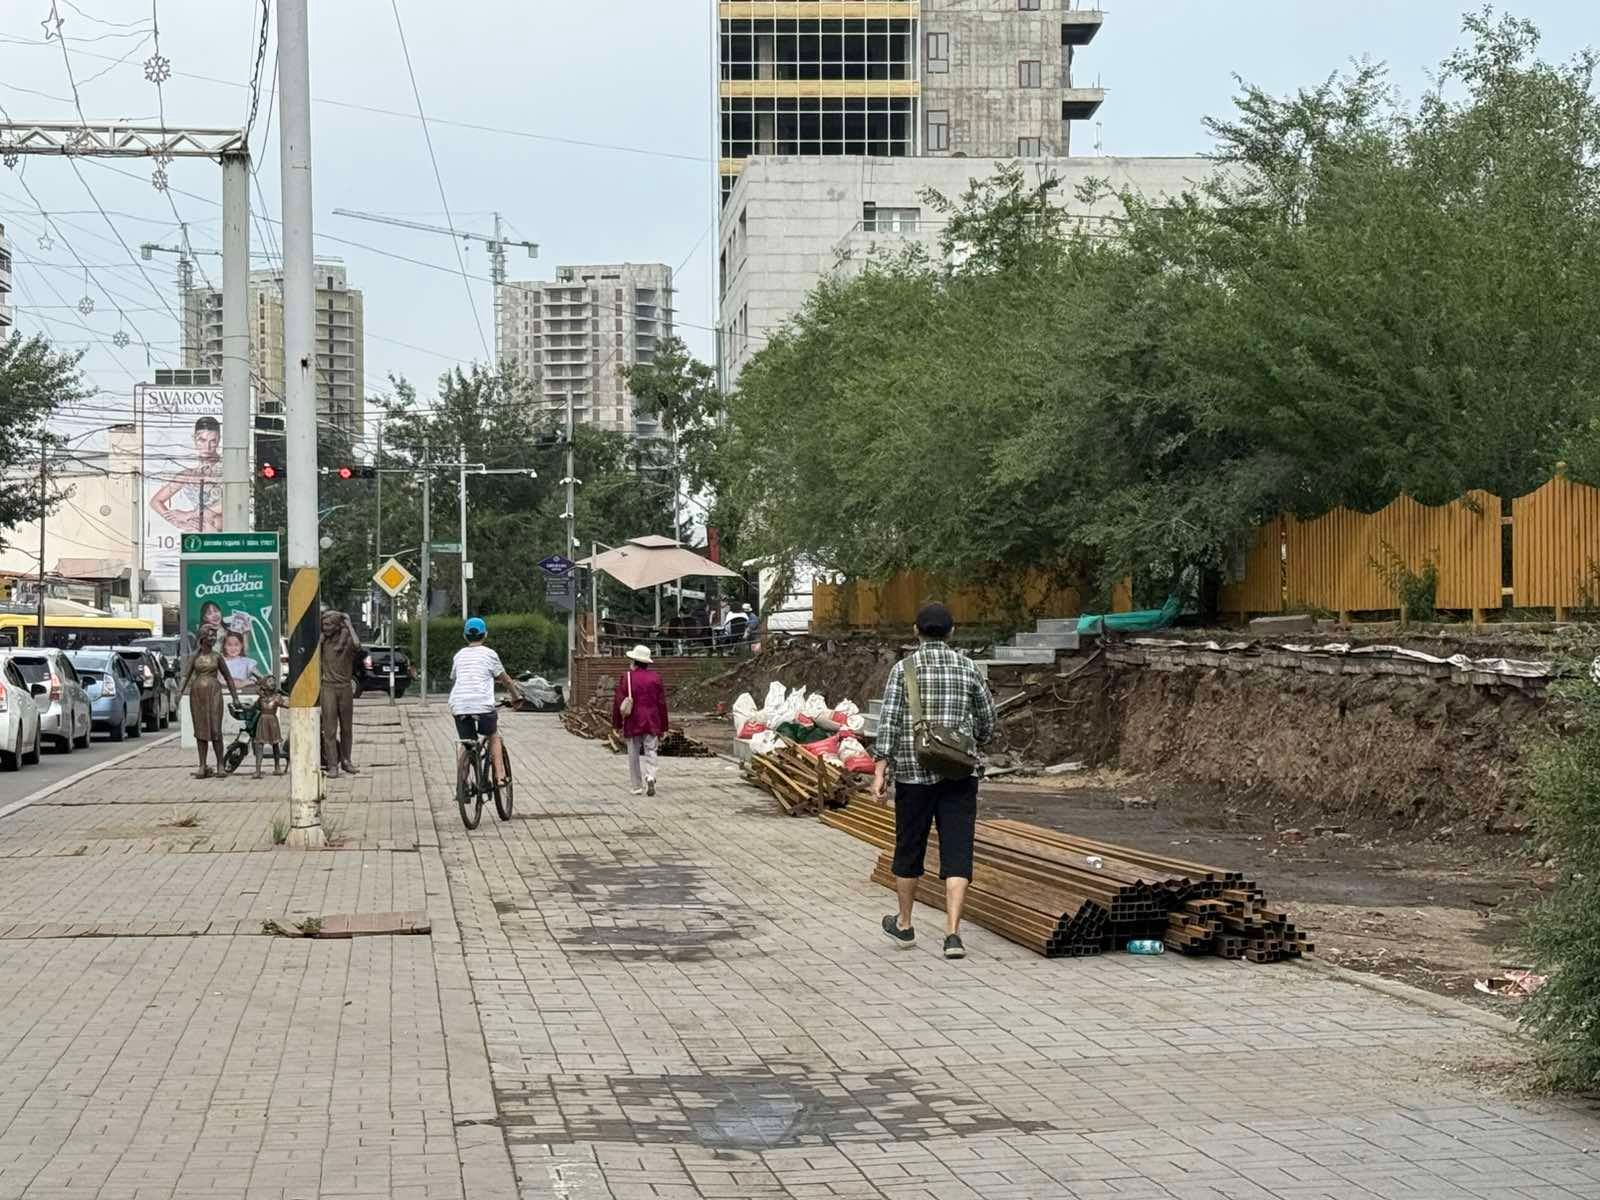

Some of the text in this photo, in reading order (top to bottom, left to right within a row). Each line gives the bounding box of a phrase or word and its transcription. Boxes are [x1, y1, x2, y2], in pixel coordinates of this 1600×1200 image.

[149, 391, 223, 405] SWAROVS
[212, 569, 247, 584] Сайн
[195, 580, 263, 598] Савлагаа
